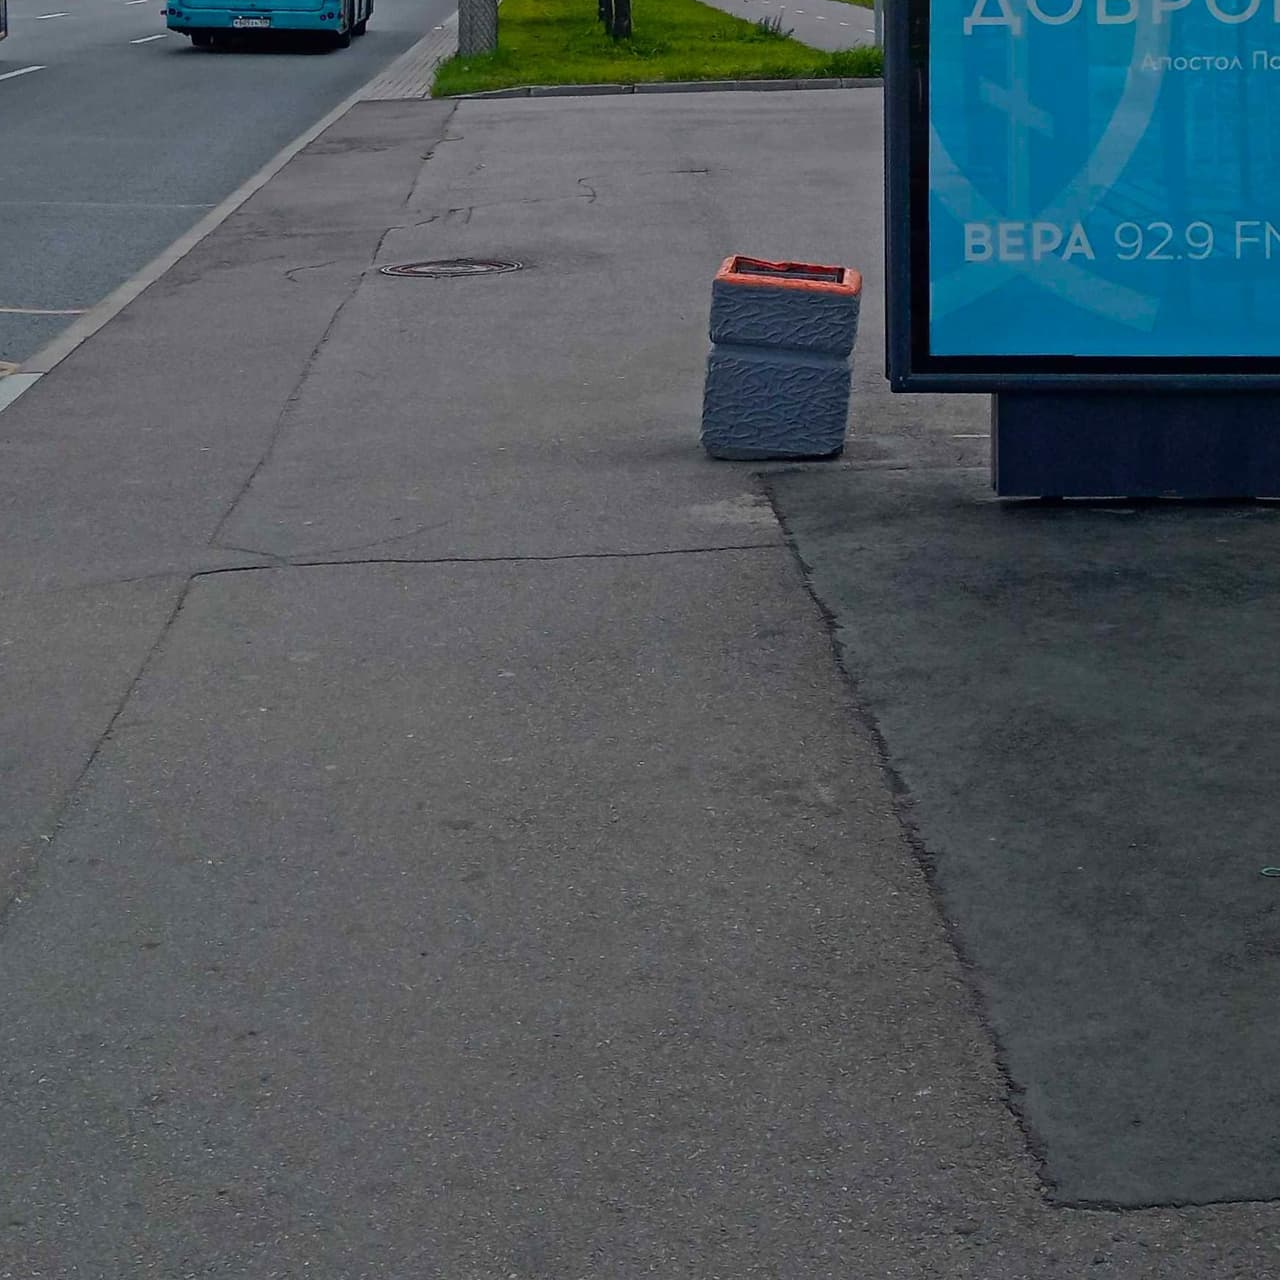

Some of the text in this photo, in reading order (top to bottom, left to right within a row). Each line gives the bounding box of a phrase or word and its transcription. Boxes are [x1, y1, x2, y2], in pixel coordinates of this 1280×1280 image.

[1141, 52, 1243, 72] Апостол
[963, 222, 1096, 262] ВЕРА
[1114, 221, 1215, 261] 92.9
